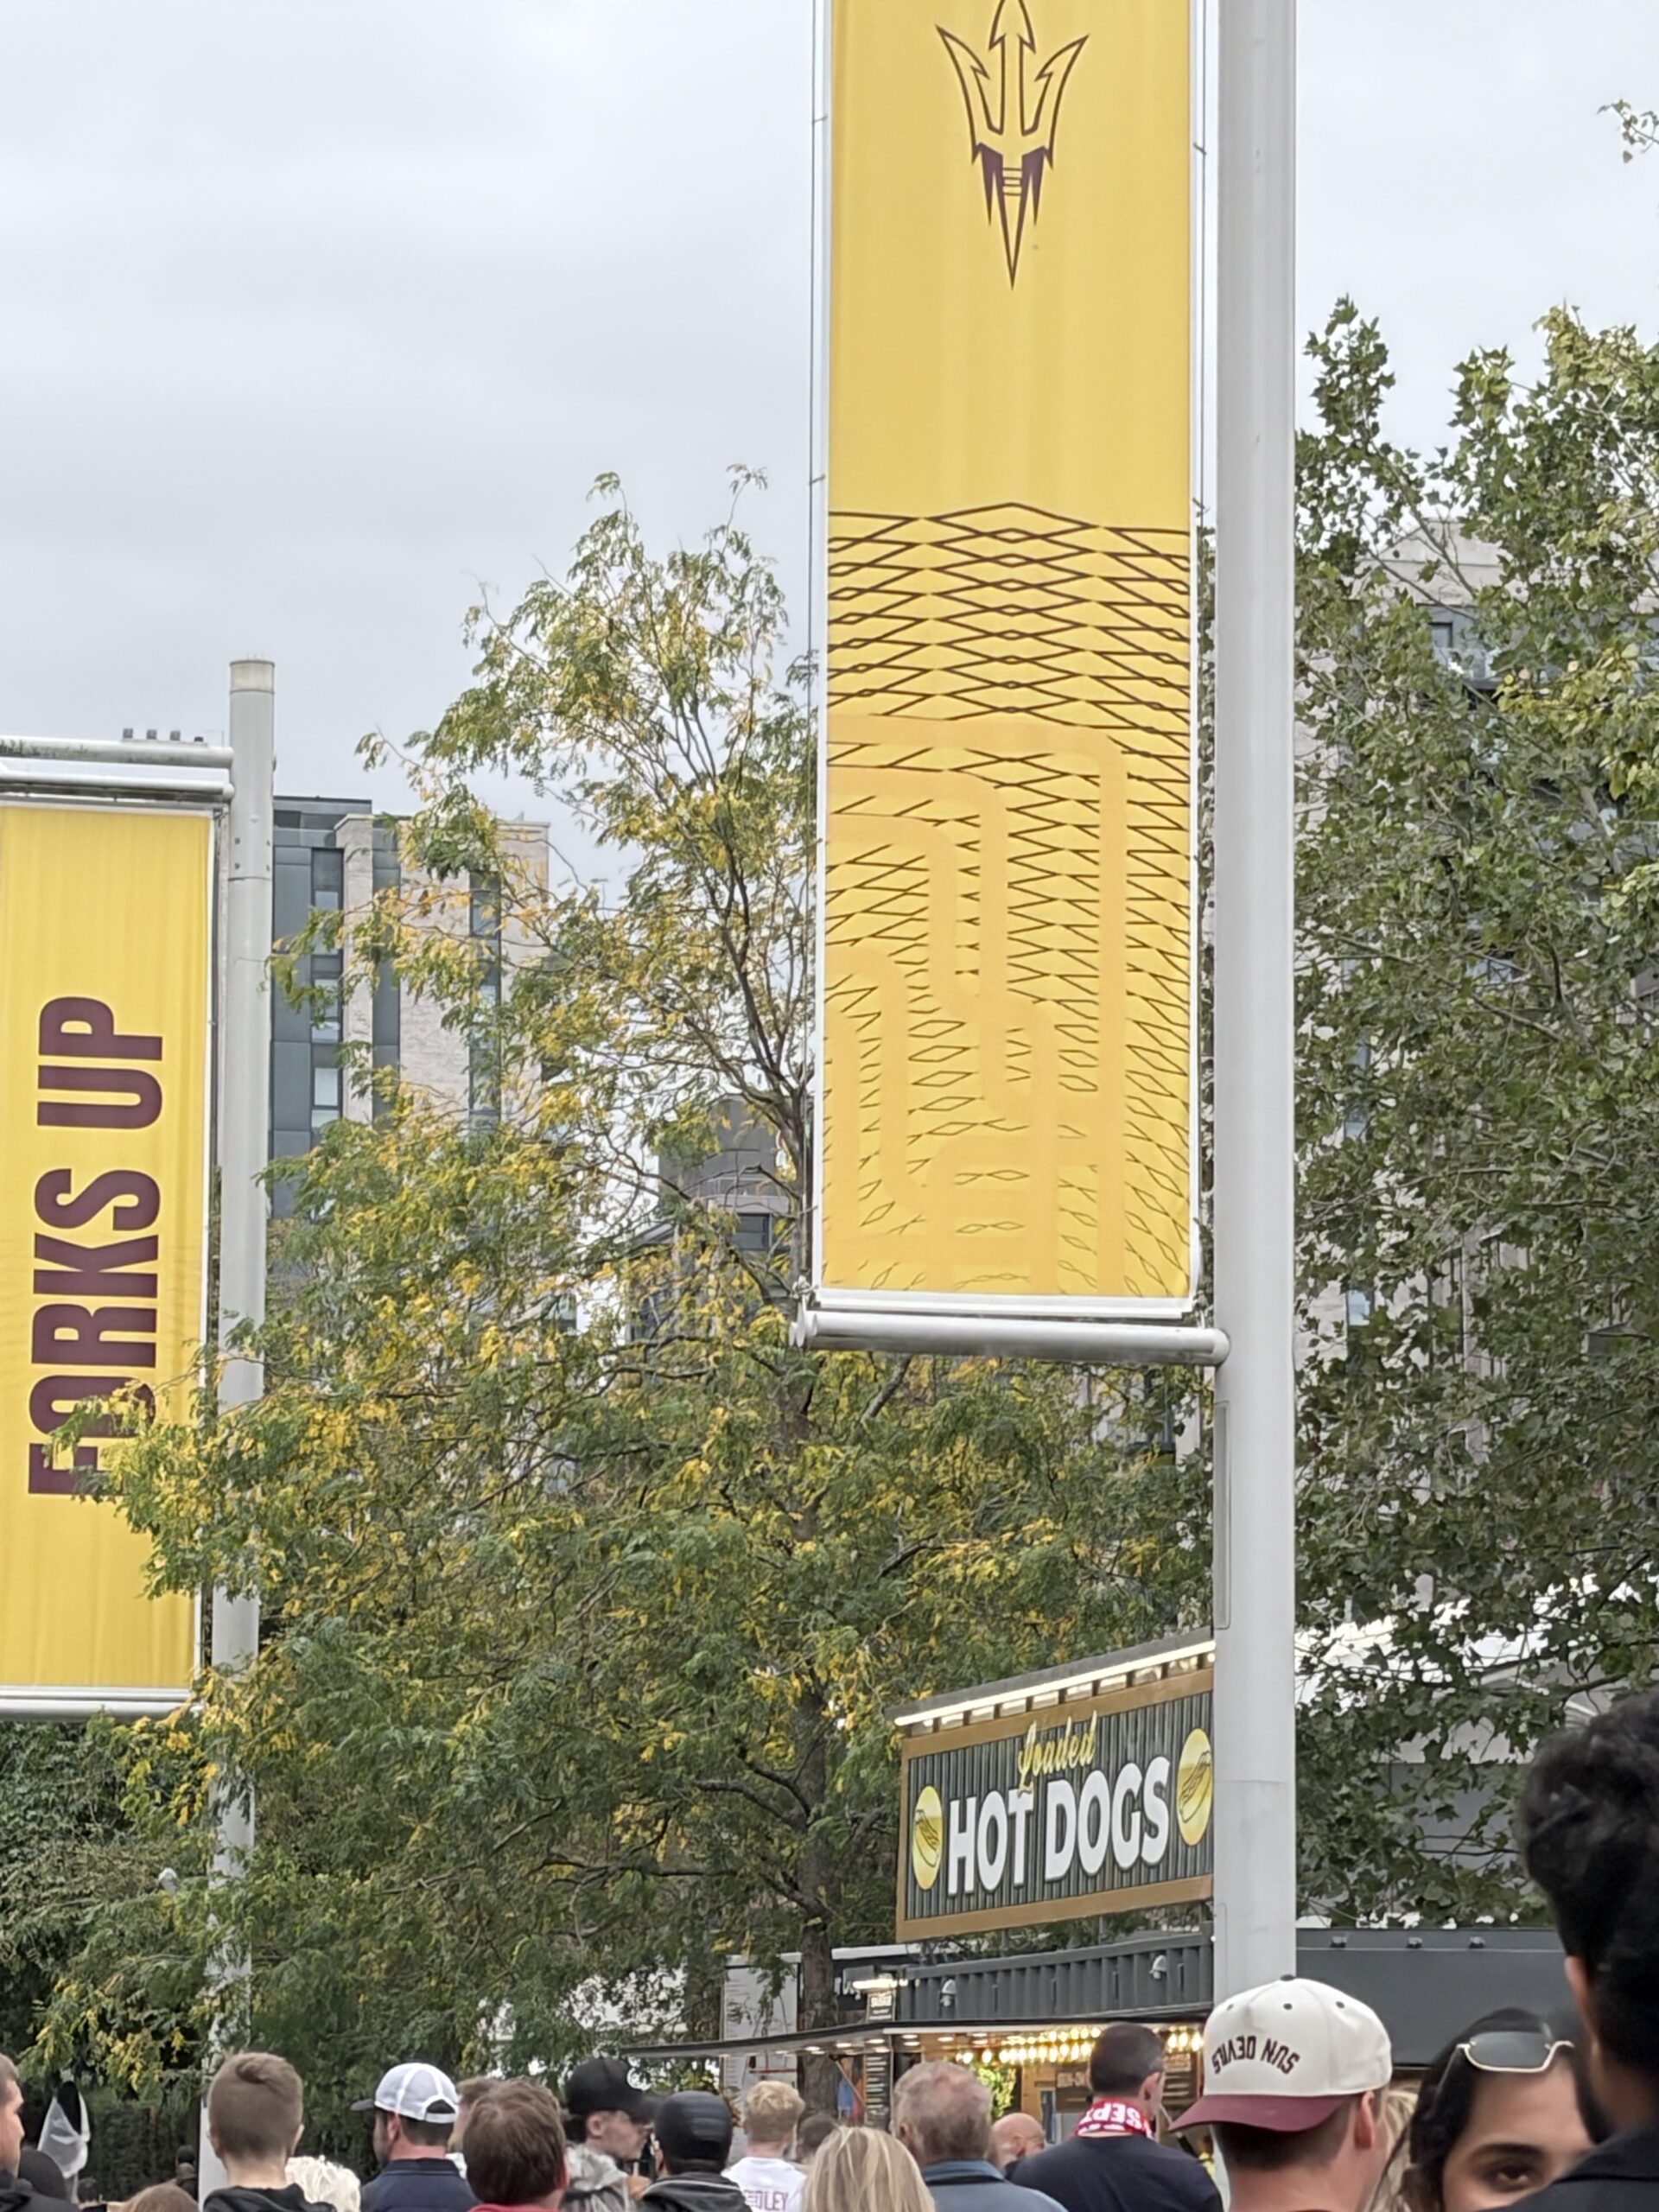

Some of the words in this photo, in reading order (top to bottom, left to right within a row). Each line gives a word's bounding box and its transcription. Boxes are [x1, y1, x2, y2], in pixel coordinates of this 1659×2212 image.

[37, 996, 162, 1129] UP
[29, 1168, 160, 1495] FORKS
[1018, 1709, 1097, 1791] Loaded
[948, 1789, 1034, 1897] HOT
[1045, 1756, 1171, 1882] DOGS
[1211, 2036, 1256, 2075] DEVILS
[1261, 2037, 1300, 2075] SUN
